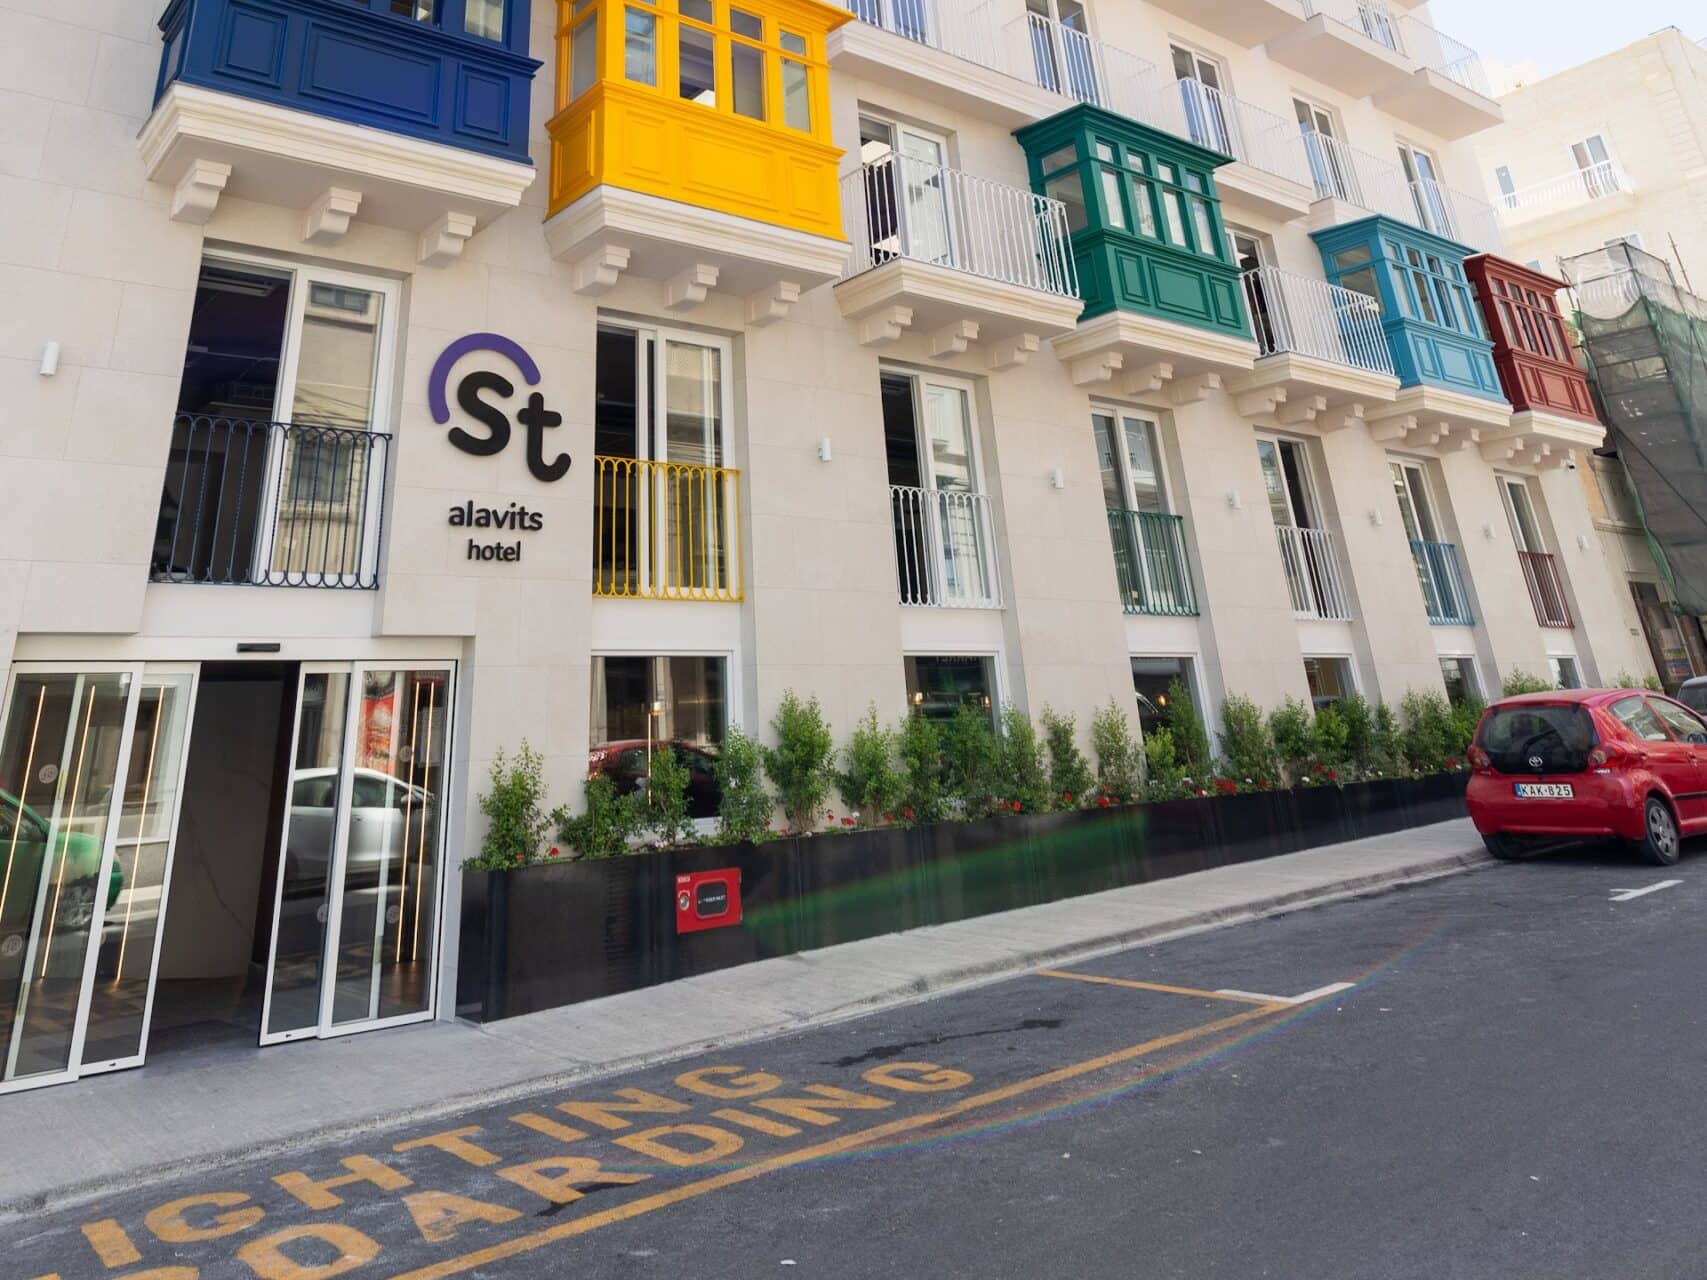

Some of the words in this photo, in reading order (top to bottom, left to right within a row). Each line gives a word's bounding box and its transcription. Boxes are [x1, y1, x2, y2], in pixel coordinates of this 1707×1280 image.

[448, 371, 572, 483] St
[448, 500, 543, 532] alavits
[467, 538, 521, 562] hotel
[31, 1065, 784, 1280] IGHTING
[109, 1061, 974, 1280] OARDING
